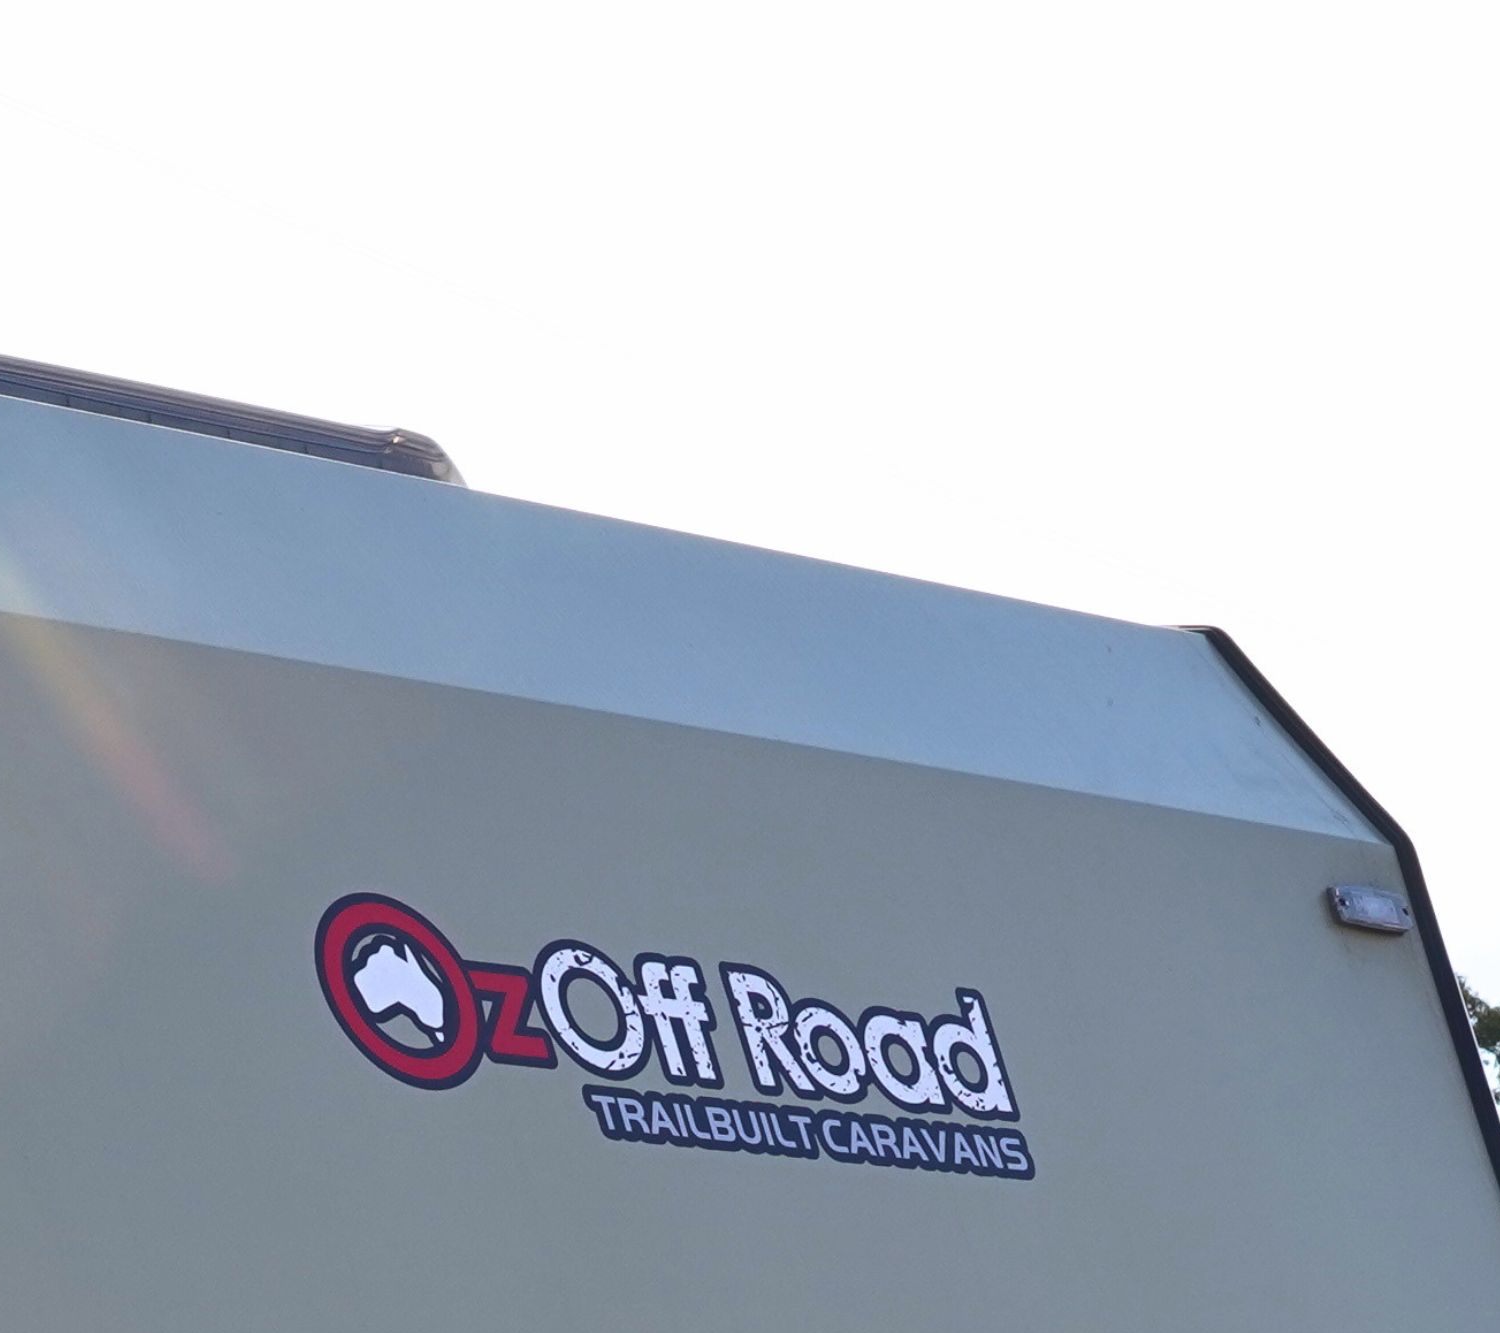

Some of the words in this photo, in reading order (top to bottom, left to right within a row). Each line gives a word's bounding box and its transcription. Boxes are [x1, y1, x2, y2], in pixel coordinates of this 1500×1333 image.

[720, 961, 1020, 1121] Road
[590, 1092, 814, 1153] TRAILBUILT
[822, 1121, 1029, 1174] CARAVANS
